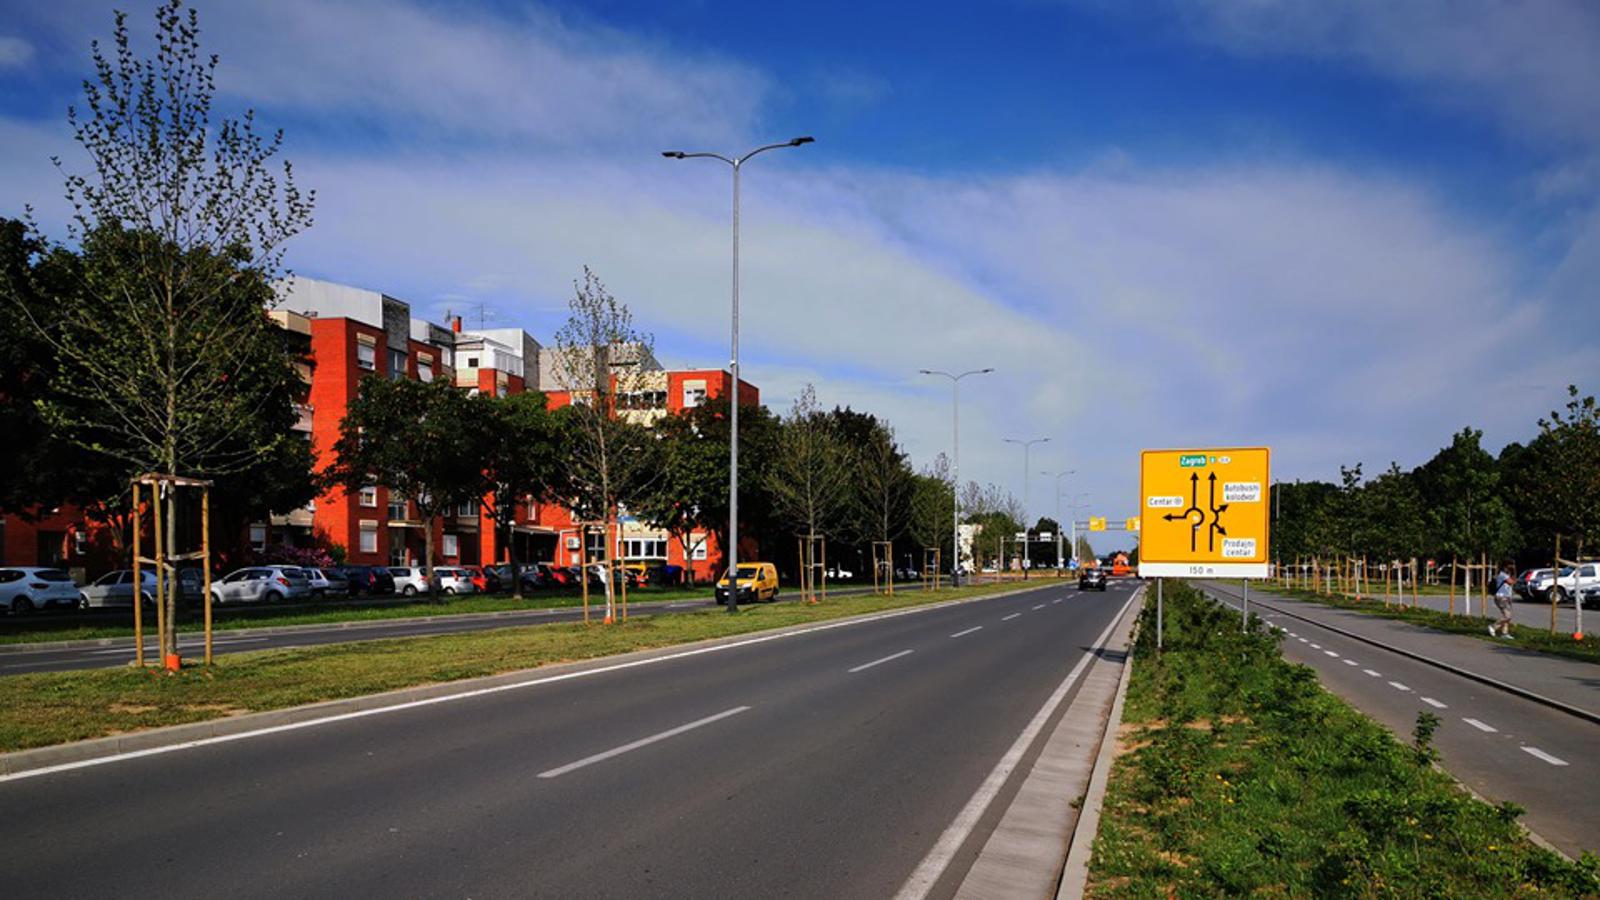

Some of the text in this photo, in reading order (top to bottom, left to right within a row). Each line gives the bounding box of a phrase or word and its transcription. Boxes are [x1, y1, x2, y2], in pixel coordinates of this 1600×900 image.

[1181, 456, 1205, 466] Zagreb
[1149, 498, 1172, 506] Centar
[1224, 539, 1254, 548] Prodajni
[1189, 566, 1204, 574] 150
